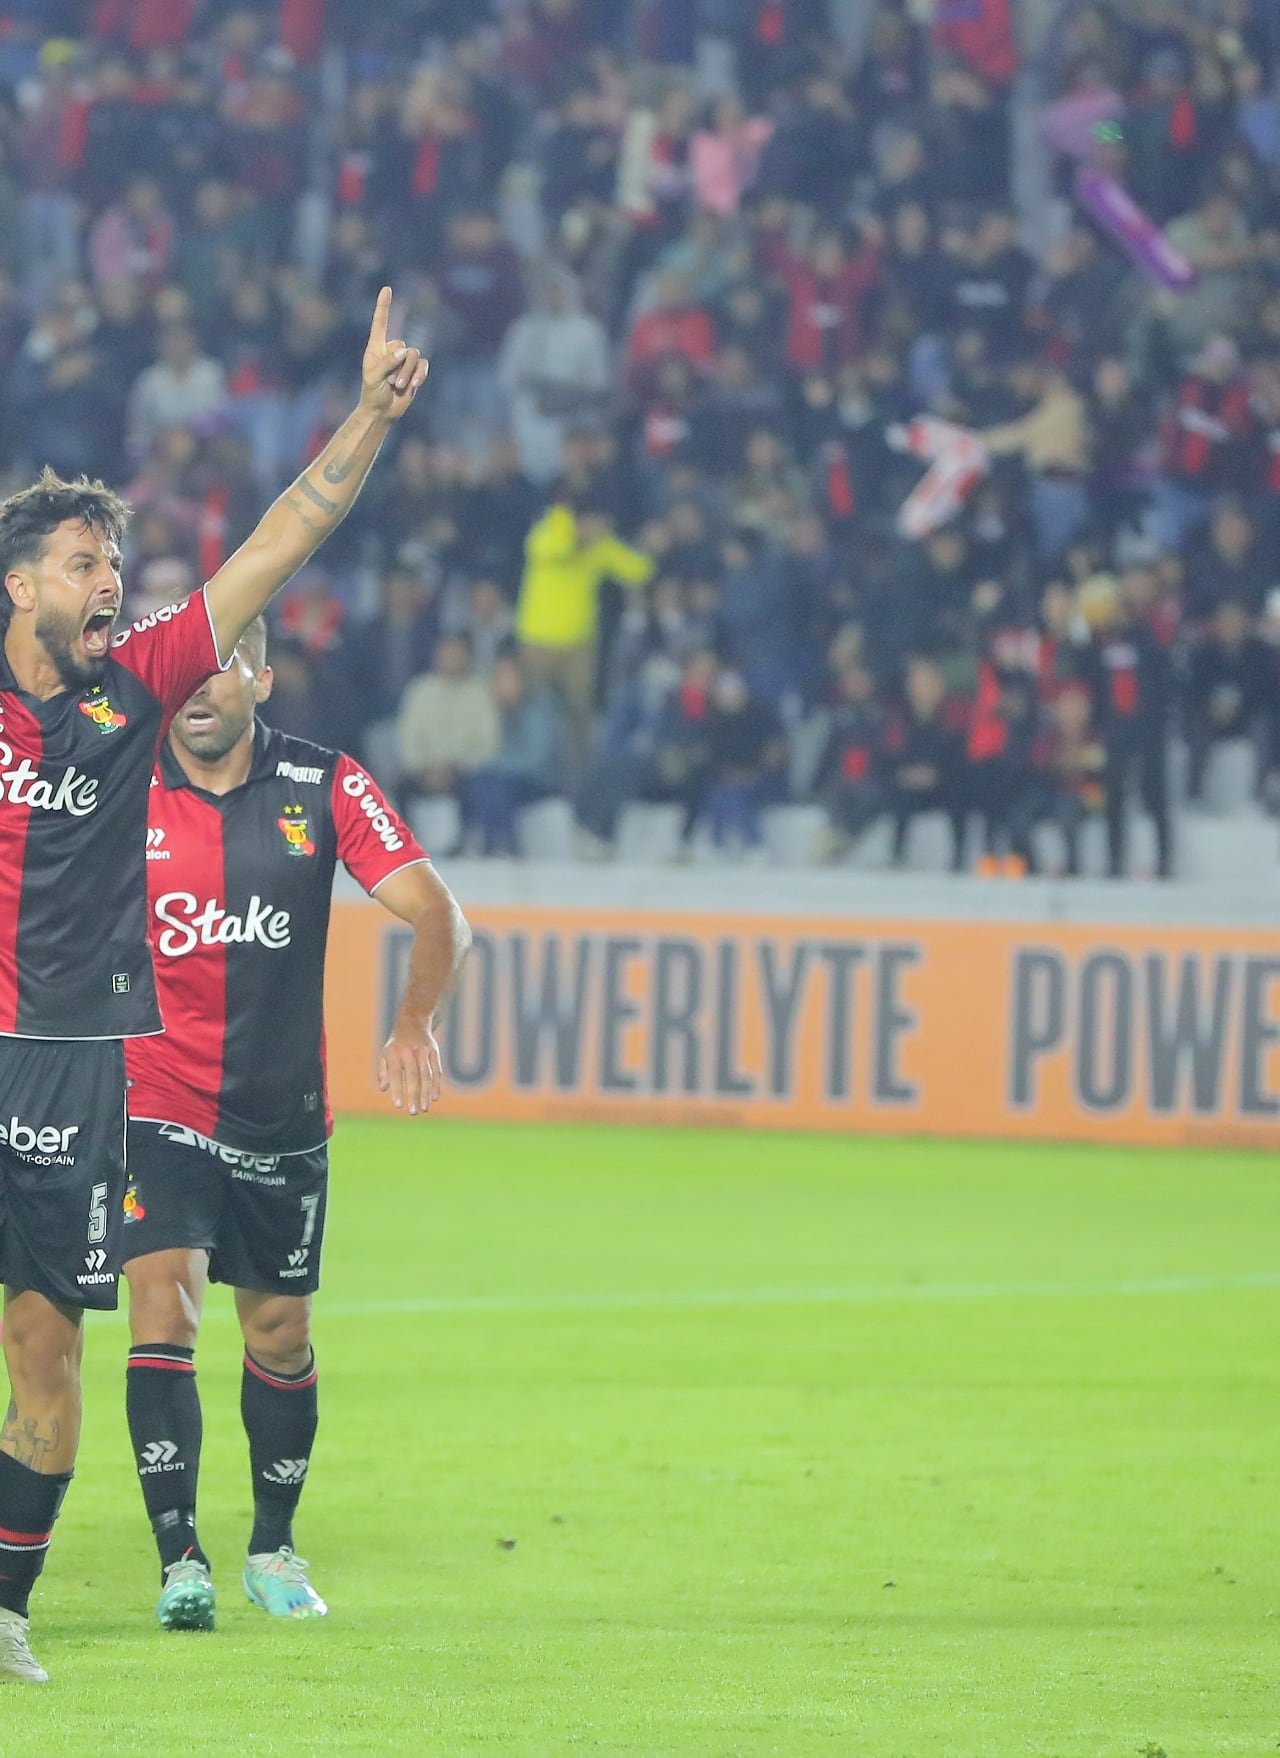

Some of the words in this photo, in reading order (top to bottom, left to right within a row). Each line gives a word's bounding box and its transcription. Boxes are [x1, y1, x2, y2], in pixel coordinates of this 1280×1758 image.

[145, 849, 171, 861] alon
[155, 891, 291, 957] Stake
[1009, 950, 1280, 1114] POWE
[87, 1181, 108, 1244] 5
[300, 1192, 320, 1247] 7
[76, 1271, 115, 1286] walon
[279, 1266, 309, 1279] walon
[138, 1461, 186, 1477] walon
